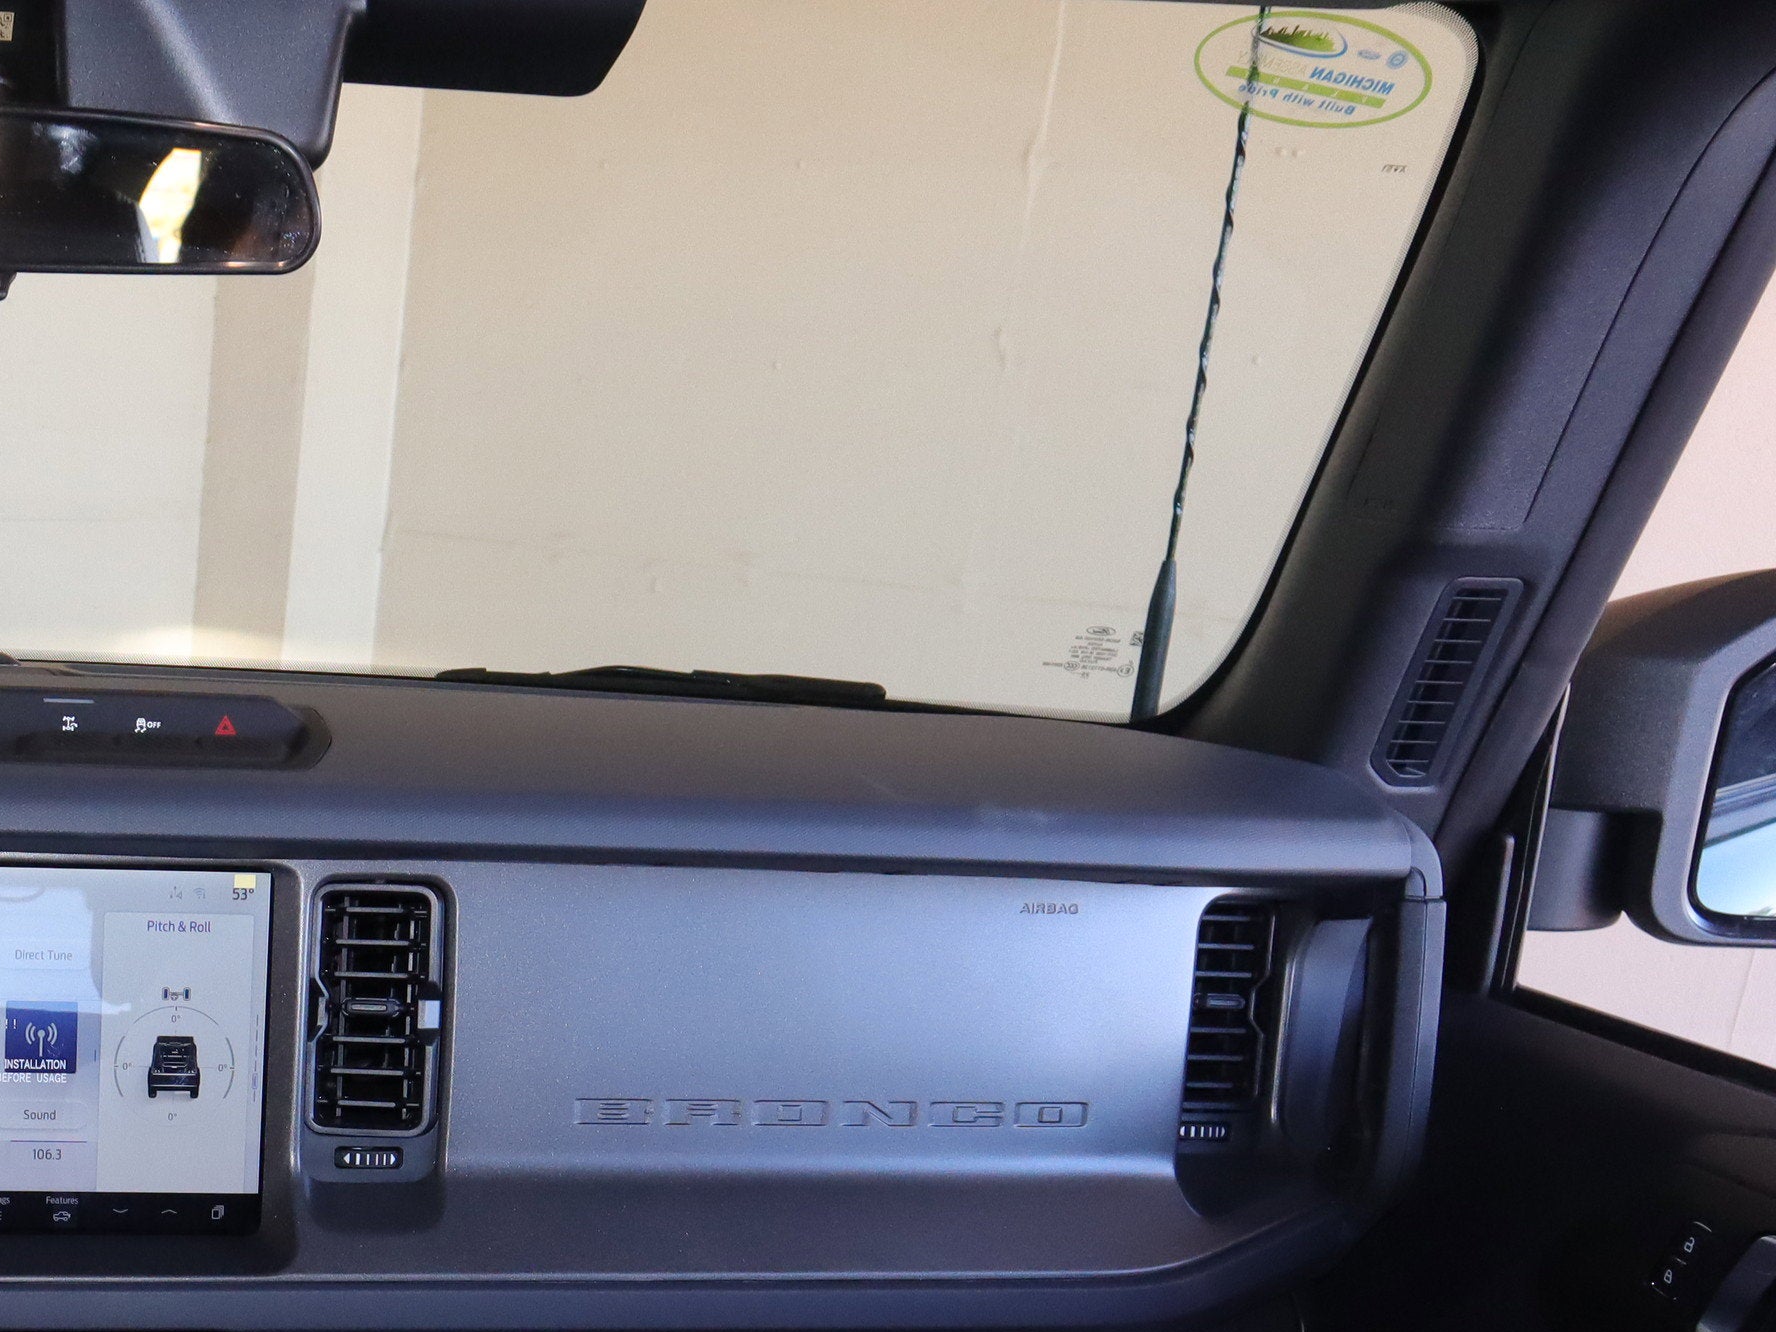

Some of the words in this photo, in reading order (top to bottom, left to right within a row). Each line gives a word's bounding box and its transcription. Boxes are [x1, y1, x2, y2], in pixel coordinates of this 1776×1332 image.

[147, 721, 161, 729] OFF
[232, 887, 255, 900] 53°
[147, 920, 175, 932] Pitch
[177, 921, 186, 932] &
[189, 921, 211, 933] Roll
[15, 949, 44, 961] Direct
[47, 950, 73, 961] Tune
[4, 1059, 67, 1070] INSTALLATION
[37, 1073, 67, 1083] USAGE
[24, 1109, 57, 1120] Sound
[572, 1098, 1089, 1128] BRONCO
[33, 1148, 62, 1160] 106.3
[46, 1196, 79, 1205] Features
